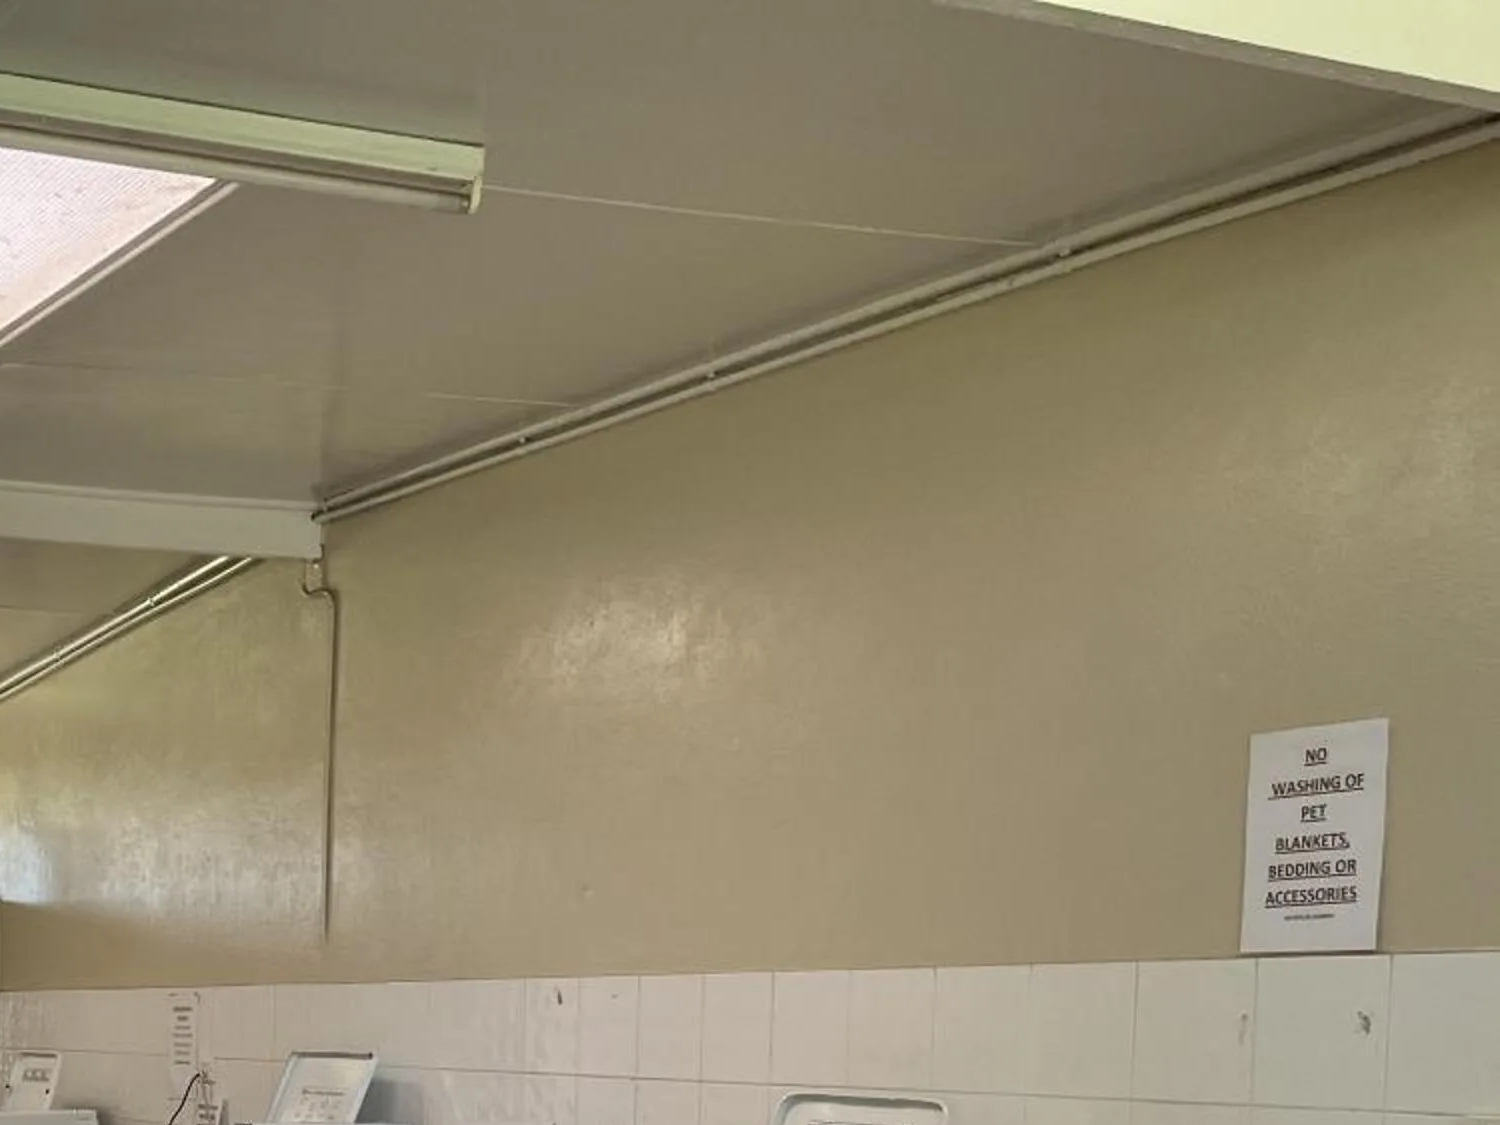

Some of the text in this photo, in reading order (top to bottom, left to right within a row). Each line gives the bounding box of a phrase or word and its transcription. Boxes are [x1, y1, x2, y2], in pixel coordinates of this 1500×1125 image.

[1305, 748, 1327, 763] NO
[1271, 773, 1364, 797] WASHING OF
[1301, 804, 1327, 819] PET
[1268, 859, 1357, 879] BEDDING OR
[1265, 886, 1357, 905] ACCESSORIES
